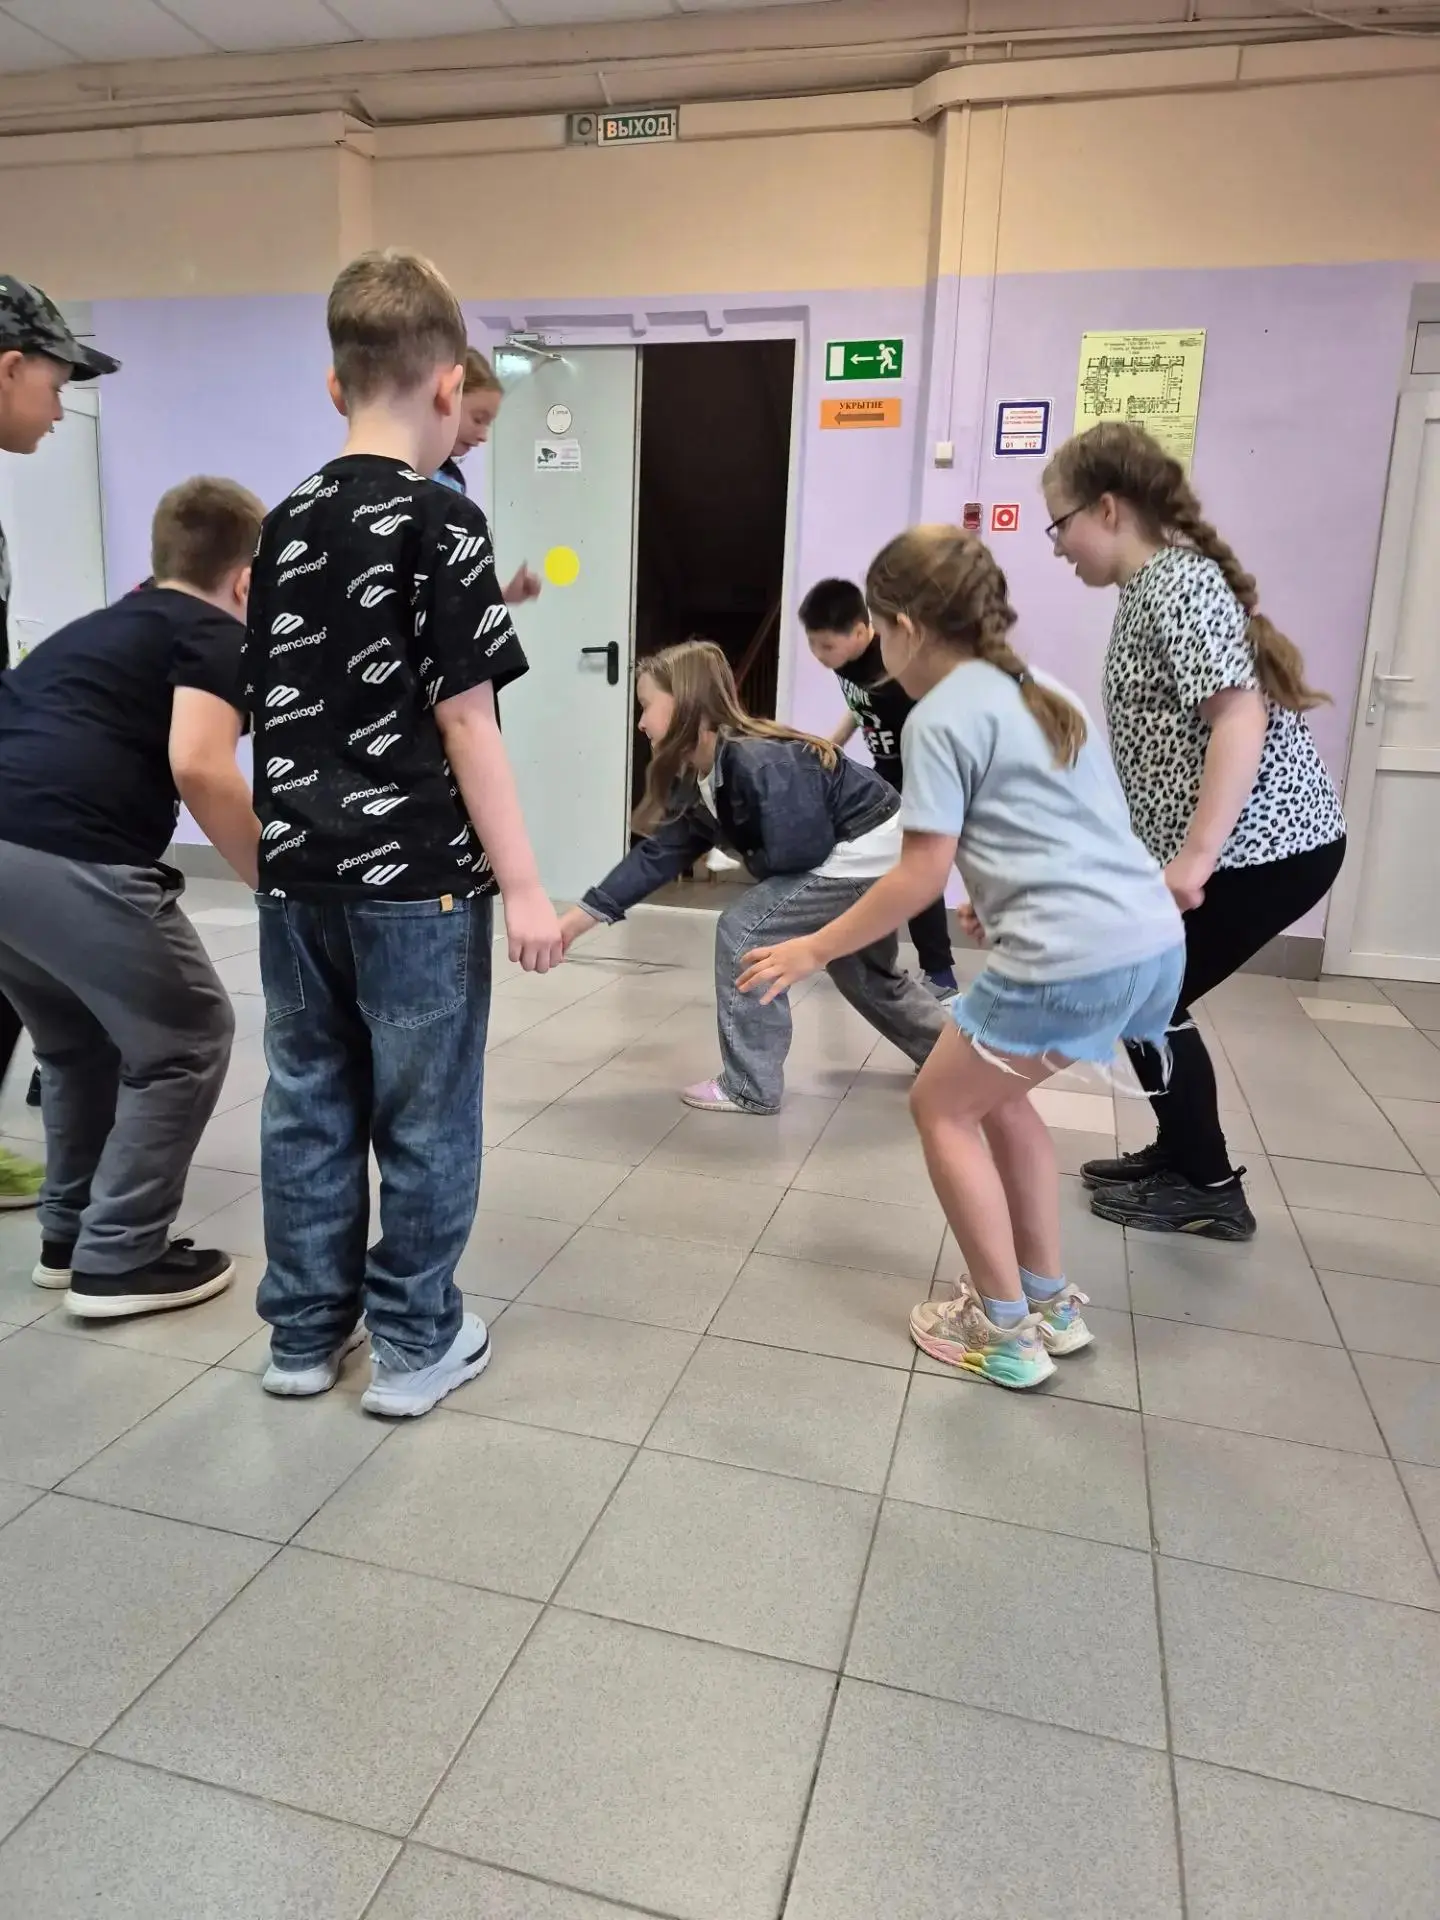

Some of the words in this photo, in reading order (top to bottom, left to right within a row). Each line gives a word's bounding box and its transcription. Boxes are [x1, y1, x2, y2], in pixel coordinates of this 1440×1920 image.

[607, 117, 670, 138] ВЫХОД
[839, 401, 884, 410] УКРЫТИЕ
[271, 773, 318, 794] enciaga
[336, 840, 401, 872] balenciaga
